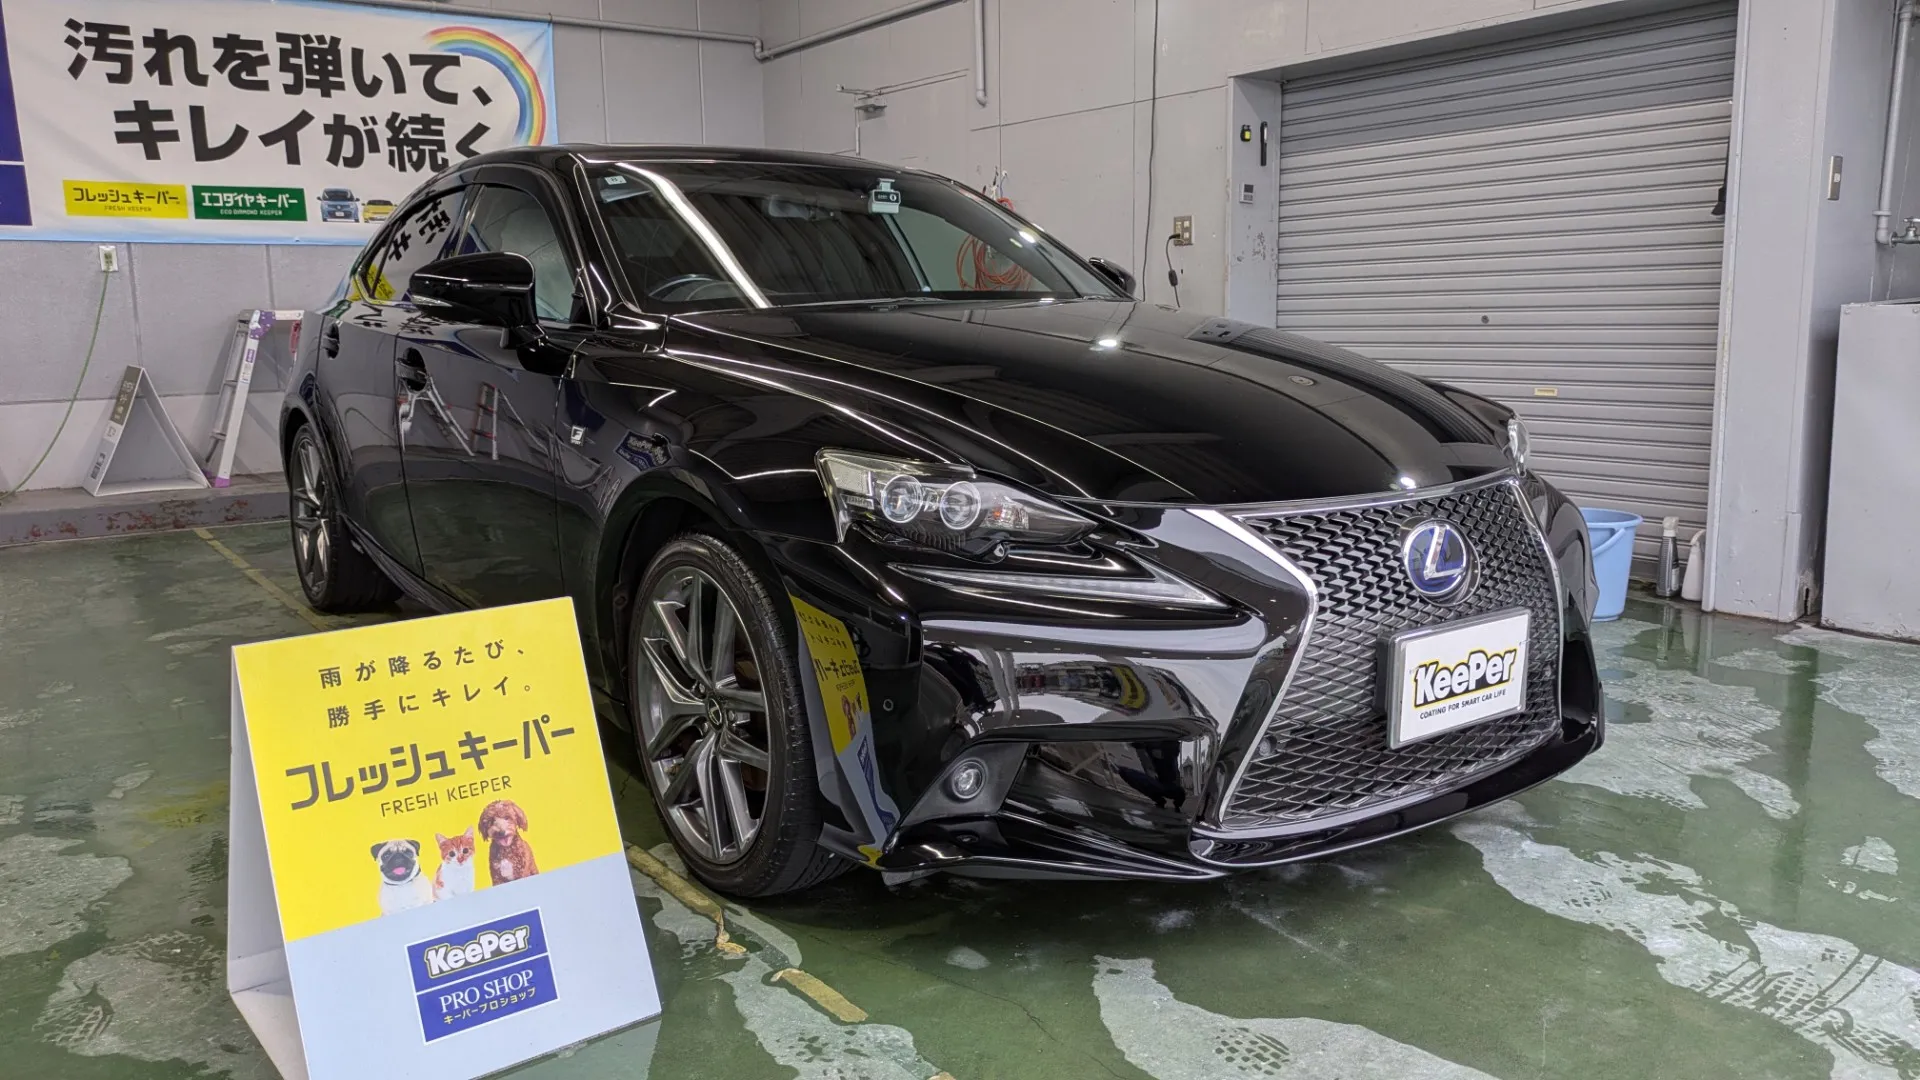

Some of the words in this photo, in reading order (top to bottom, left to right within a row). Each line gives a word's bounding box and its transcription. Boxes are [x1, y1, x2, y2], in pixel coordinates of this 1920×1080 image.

[64, 18, 493, 106] 汚れを弾いて、
[114, 100, 491, 173] キレイが続く
[73, 187, 179, 205] フレッシュキーパー
[201, 192, 298, 208] エコダイヤキーパー
[318, 639, 525, 689] 雨が降るたび、
[1414, 648, 1517, 709] KeePer
[327, 676, 531, 729] 勝手にキレイ。
[1419, 705, 1447, 720] COATING
[1447, 702, 1460, 712] FOR
[1461, 696, 1480, 708] SMART
[1481, 693, 1492, 702] CAR
[1493, 688, 1506, 698] LIFE
[285, 714, 576, 811] フレッシュキーパー
[380, 791, 439, 818] FRESH
[446, 775, 512, 802] KEEPER
[424, 925, 530, 979] KeePer
[439, 986, 480, 1013] PRO
[484, 969, 533, 999] SHOP
[443, 987, 537, 1025] キーパープロショップ
